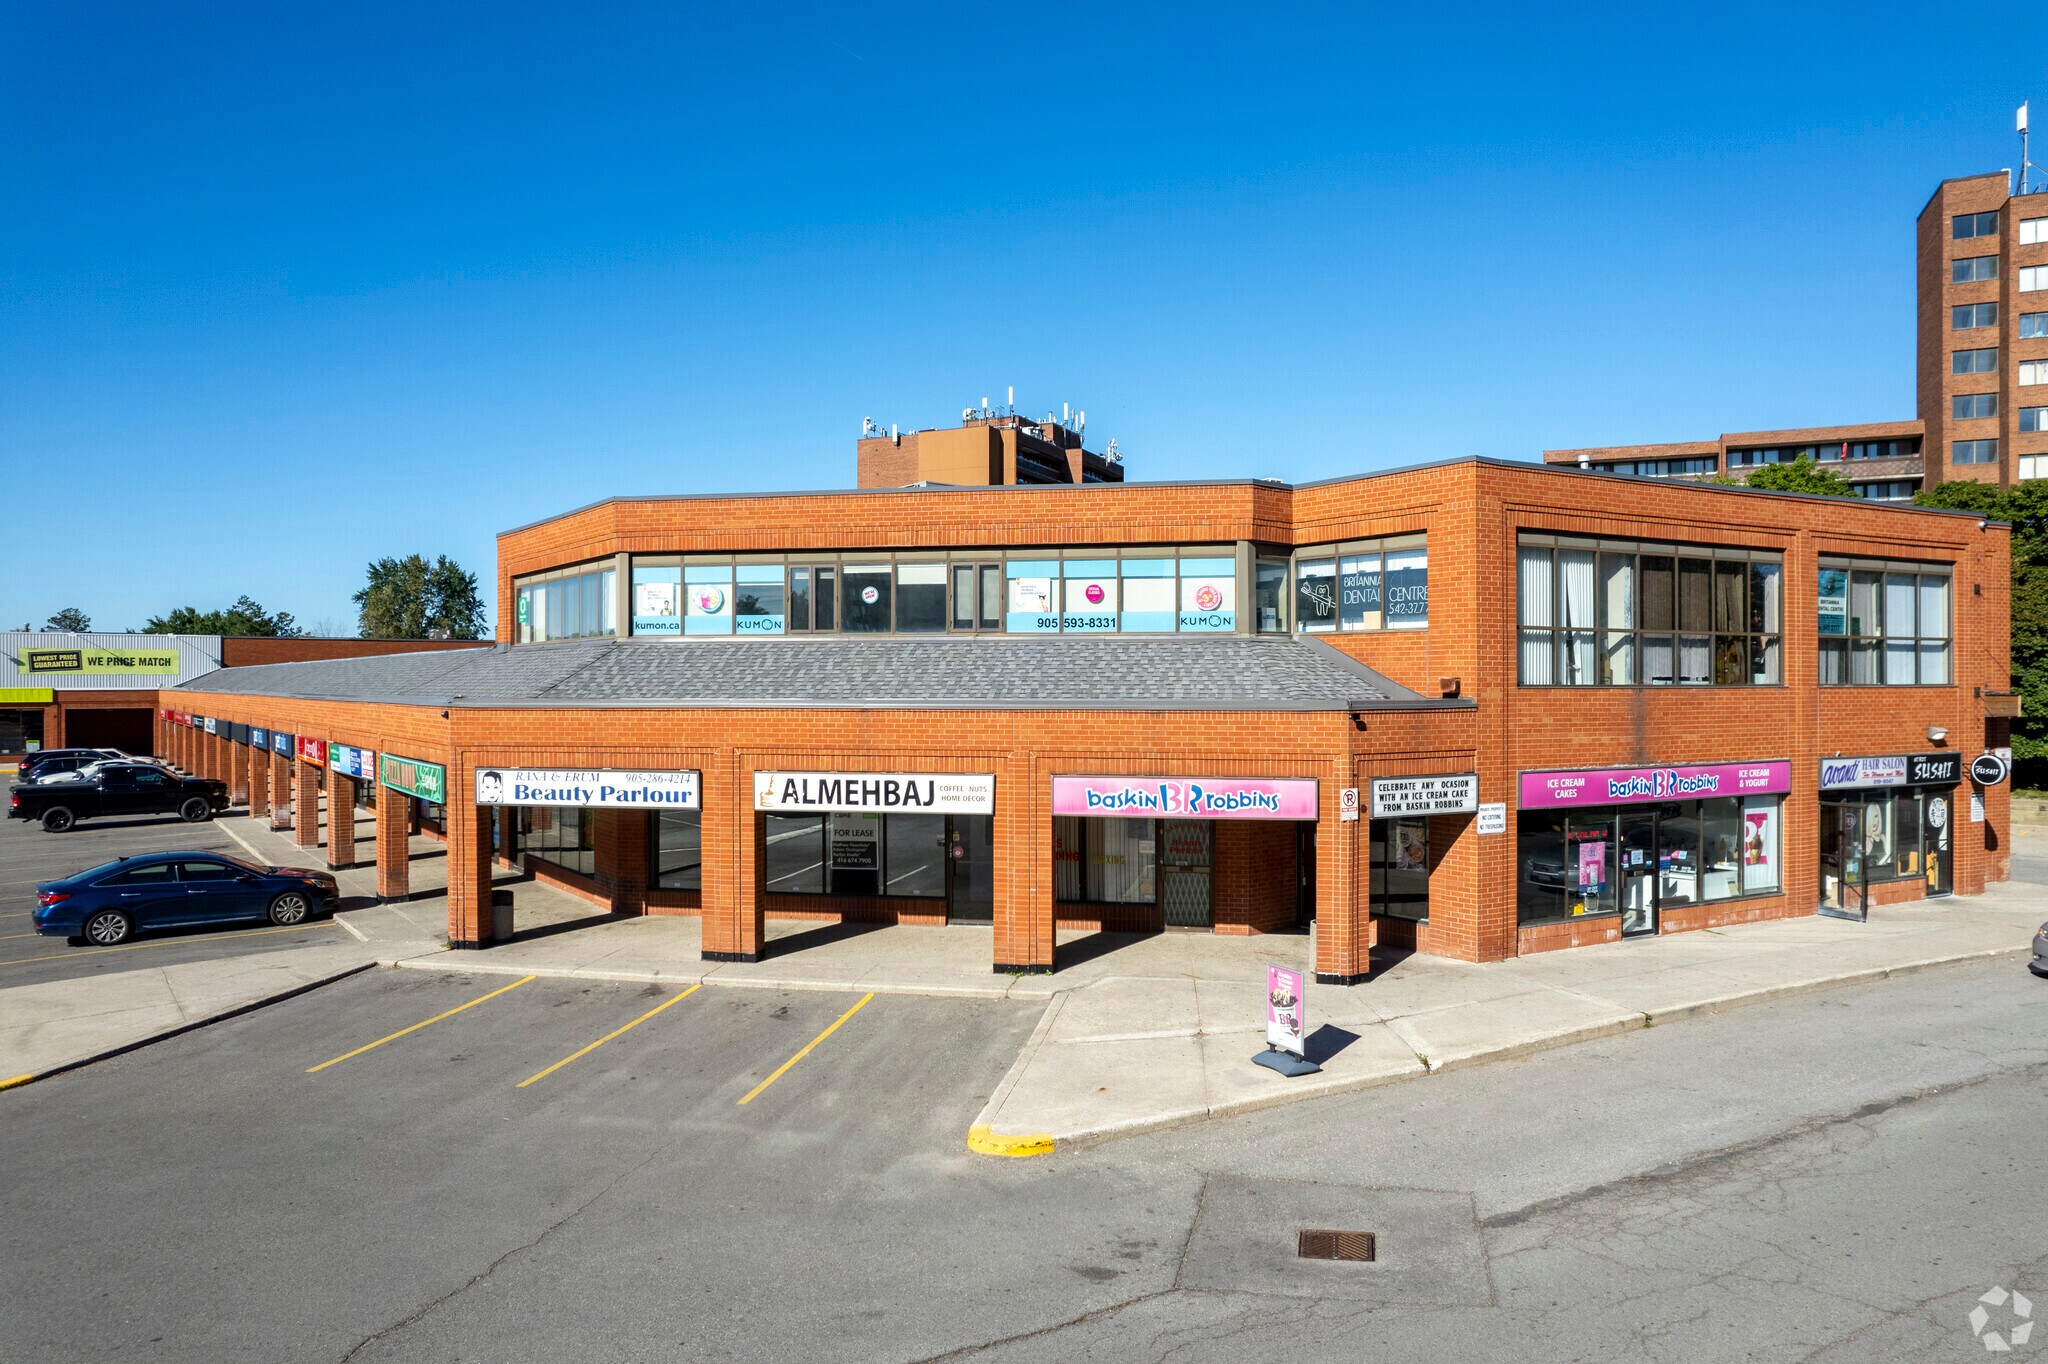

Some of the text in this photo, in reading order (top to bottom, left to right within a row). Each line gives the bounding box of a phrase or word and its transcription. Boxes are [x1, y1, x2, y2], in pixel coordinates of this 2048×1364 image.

[1344, 573, 1381, 588] BRITANNIA
[1344, 588, 1381, 604] DENTAL
[634, 620, 680, 630] kumon.ca
[736, 619, 782, 630] KUMON
[1037, 618, 1116, 628] 905 593-8331
[1180, 614, 1233, 628] KUMON
[33, 654, 58, 662] LOWEST
[88, 656, 171, 666] WE PRICE MATCH
[34, 660, 78, 668] GUARANTEED
[1862, 759, 1880, 770] HAIR
[1882, 758, 1905, 770] SALON
[1738, 769, 1769, 778] ICE CREAM
[1914, 762, 1954, 780] SUSHI
[1378, 783, 1416, 792] CELEBRATE
[1441, 780, 1469, 788] OCASION
[1547, 778, 1585, 788] ICE CREAM
[1746, 779, 1768, 787] YOGURT
[514, 784, 692, 805] Beauty Parlour
[781, 778, 935, 806] ALMEHBAJ
[1379, 794, 1396, 802] WITH
[1412, 792, 1422, 800] ICE
[1426, 790, 1448, 799] CREAM
[1451, 790, 1468, 798] CAKE
[1554, 789, 1578, 798] CAKES
[1383, 800, 1463, 812] FROM BASKIN ROBBINS
